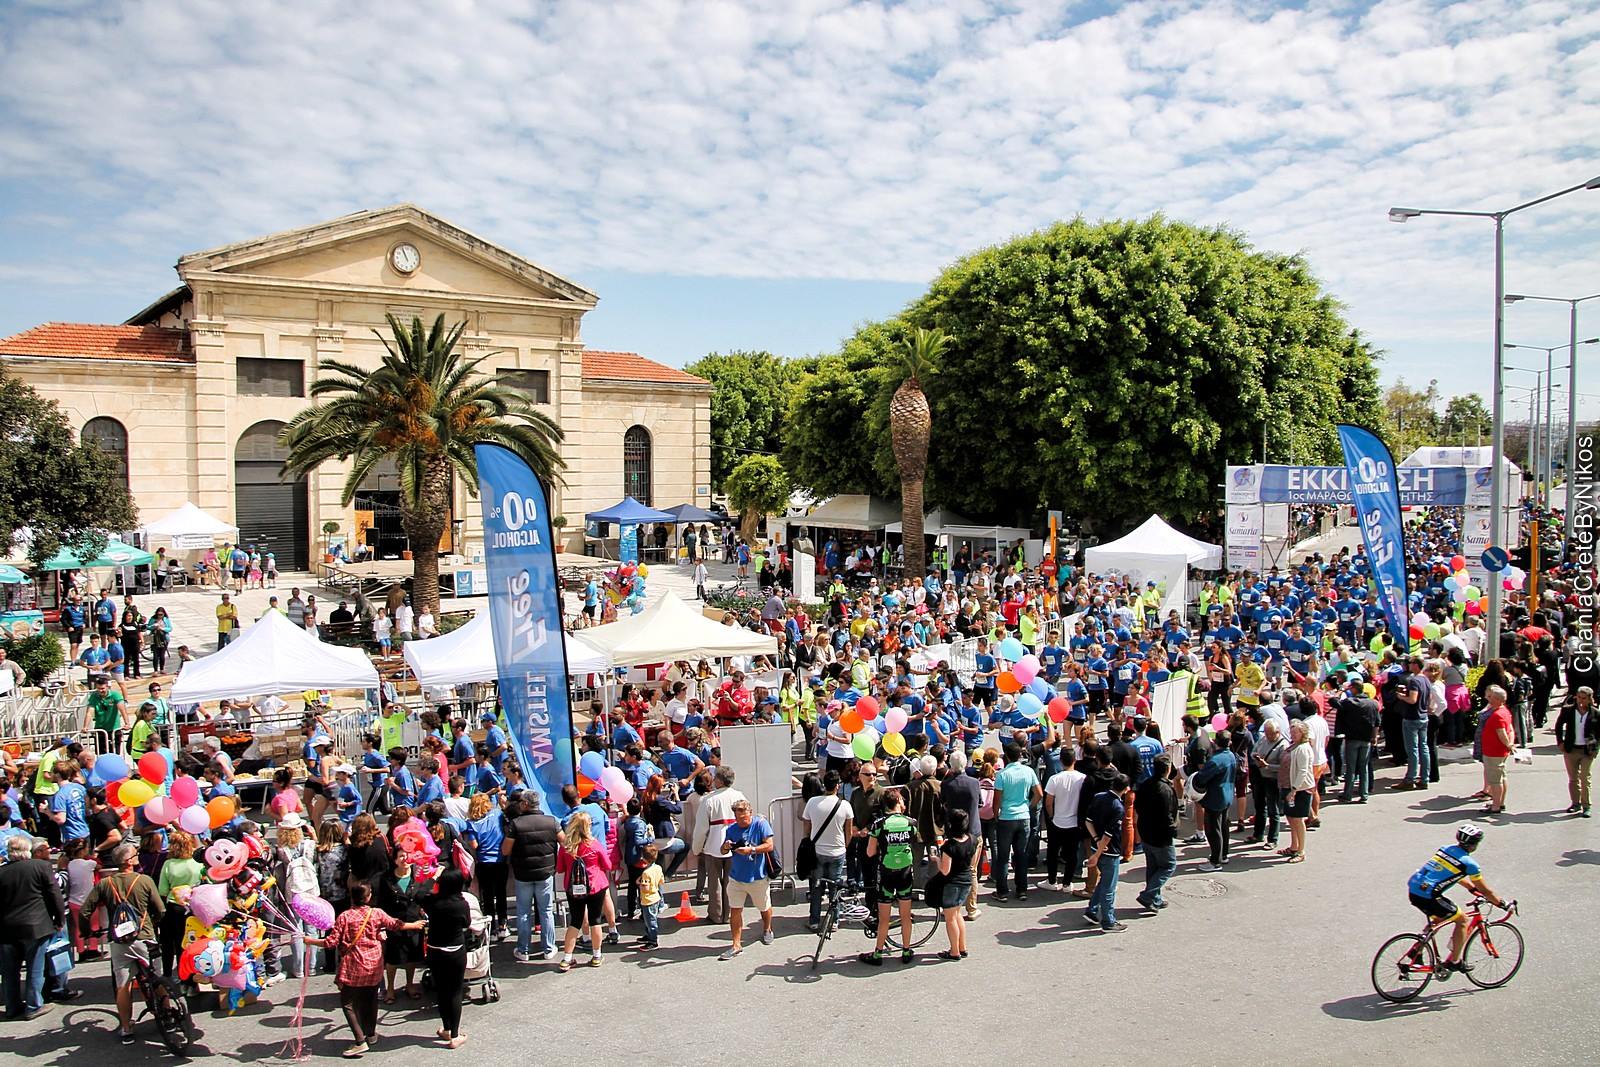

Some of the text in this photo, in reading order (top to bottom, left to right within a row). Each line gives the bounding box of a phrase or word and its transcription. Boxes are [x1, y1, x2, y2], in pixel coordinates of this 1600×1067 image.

[1287, 468, 1434, 491] ΕΚΚΙΣΗ
[1306, 491, 1353, 501] ΜΑΡΑΘΩ
[1400, 491, 1434, 502] ΗΤΗΣ
[1465, 535, 1490, 545] Sama
